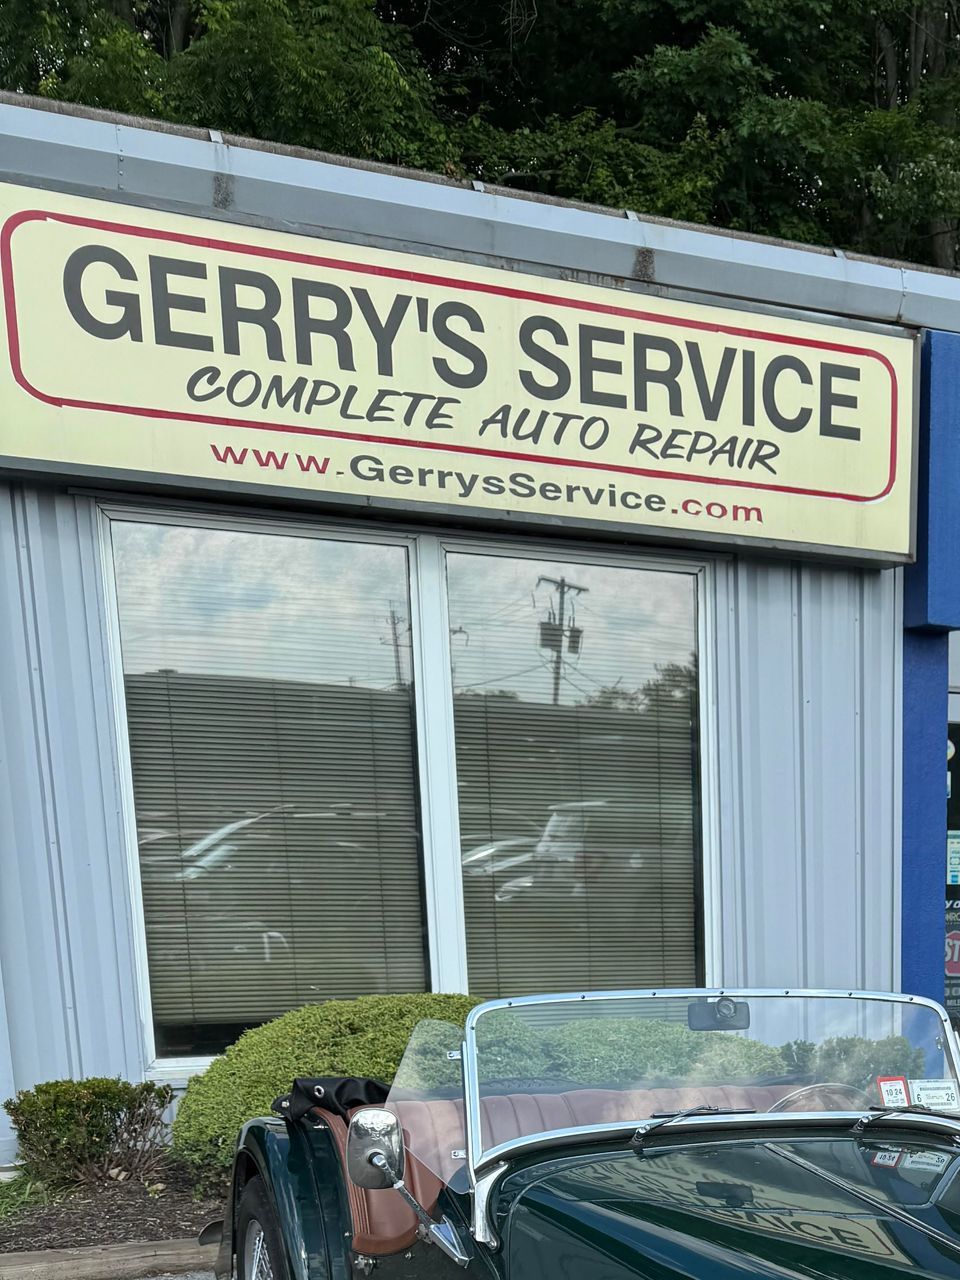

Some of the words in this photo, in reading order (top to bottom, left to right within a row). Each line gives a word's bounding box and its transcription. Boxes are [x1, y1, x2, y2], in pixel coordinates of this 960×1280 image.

[62, 244, 489, 389] GERRY'S
[518, 315, 862, 441] SERVICE
[186, 365, 462, 430] COMPLETE
[478, 404, 610, 450] AUTO
[628, 423, 781, 475] REPAIR
[209, 443, 764, 524] www.GerrysService.com
[945, 899, 960, 909] YO
